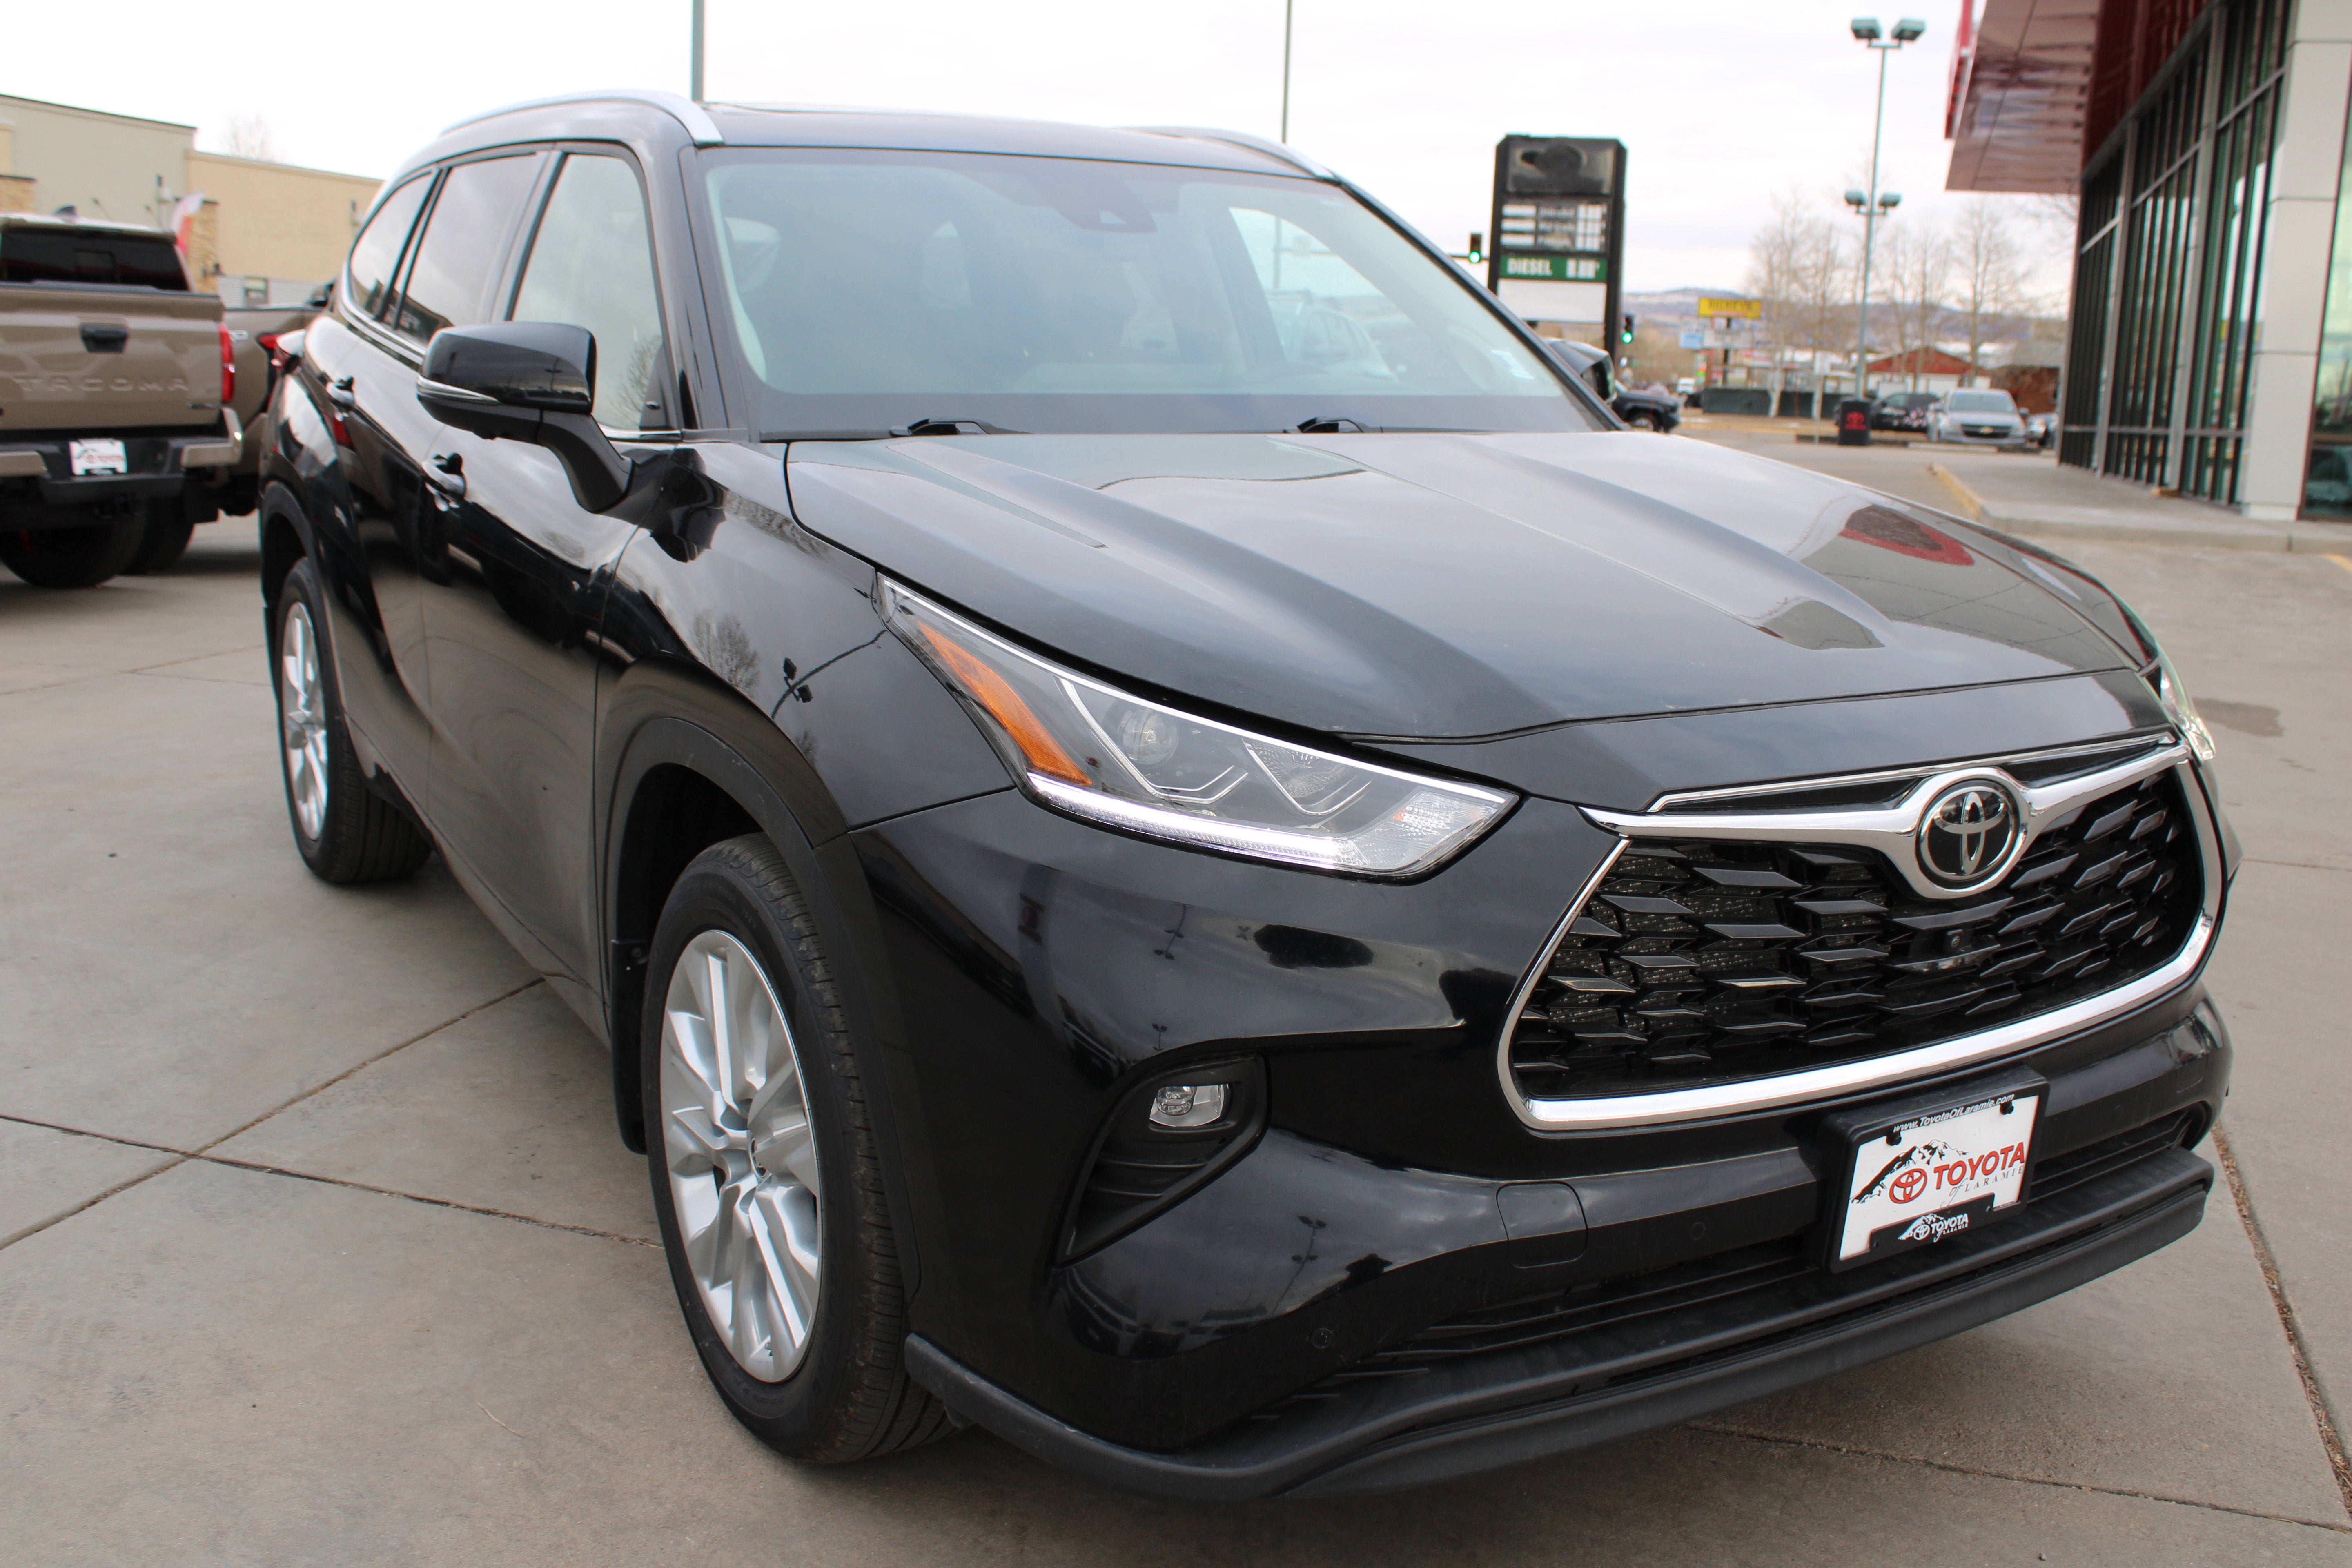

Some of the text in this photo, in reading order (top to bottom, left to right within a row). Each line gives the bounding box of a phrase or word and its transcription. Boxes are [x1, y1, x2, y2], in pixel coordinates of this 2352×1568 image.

[1507, 257, 1553, 276] DIESEL
[11, 377, 189, 392] TACOMA
[1933, 1141, 2025, 1190] TOYOTA
[1964, 1165, 2024, 1192] LARAMIE
[1931, 1213, 1969, 1234] TOYOTA
[1942, 1223, 1968, 1235] LARAMIE
